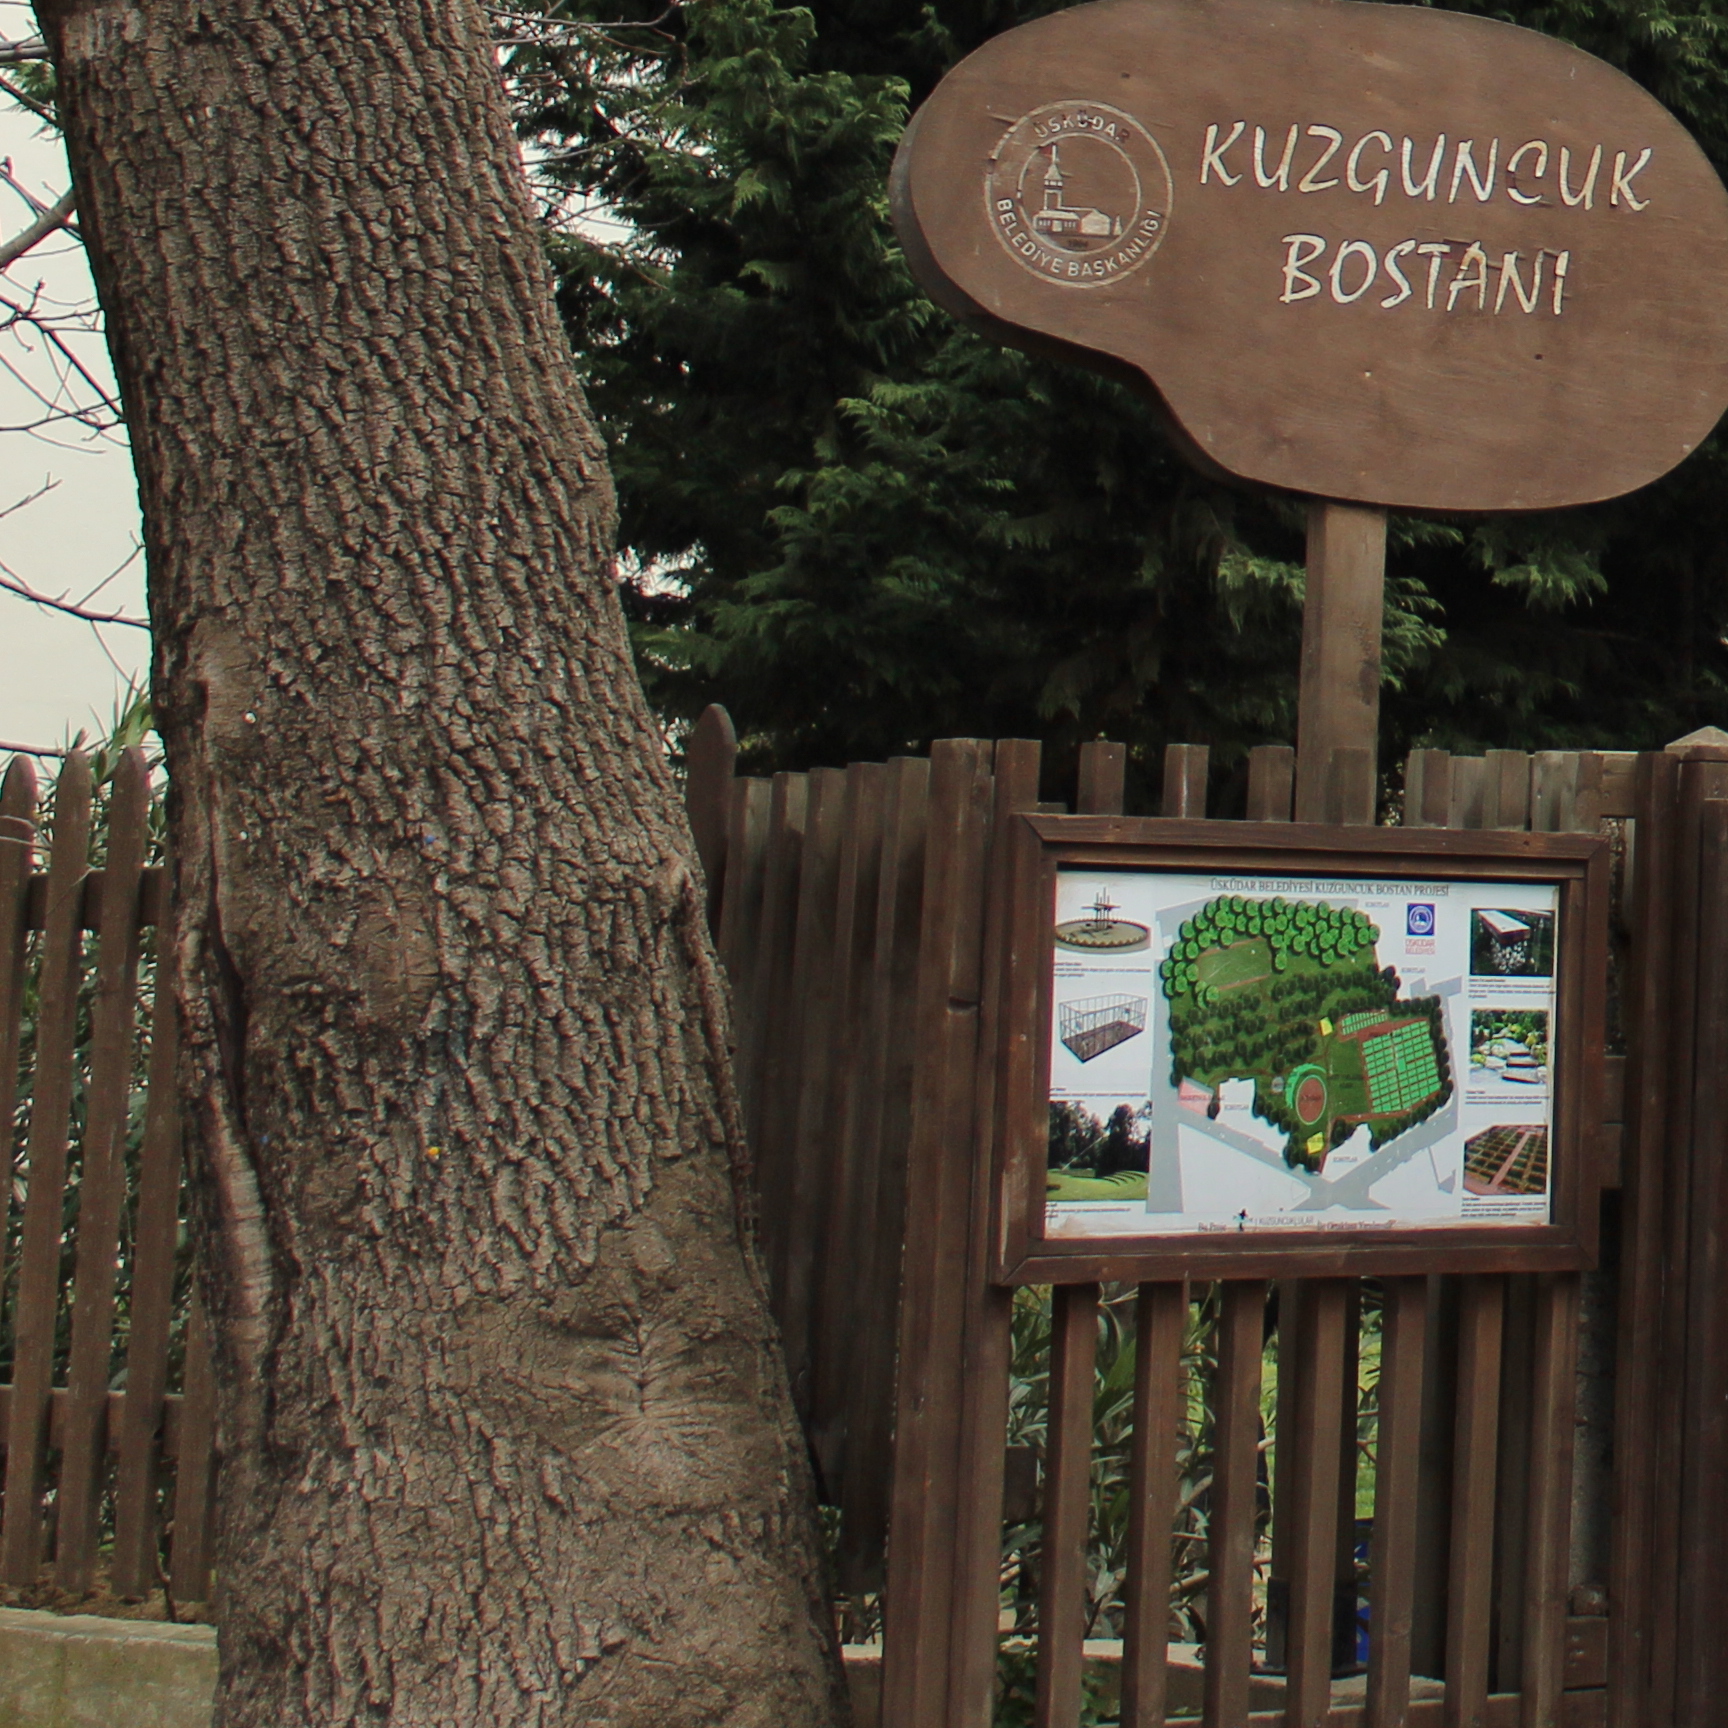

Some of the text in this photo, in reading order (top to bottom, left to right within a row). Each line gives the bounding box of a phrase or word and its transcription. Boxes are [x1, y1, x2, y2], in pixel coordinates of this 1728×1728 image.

[1200, 120, 1652, 212] KUZGUNCUK
[996, 199, 1163, 277] BELEDİYE BAŞKANLIĞI
[1279, 233, 1570, 316] BOSTANI
[1211, 878, 1256, 891] ÜSKÜDAR
[1259, 880, 1313, 892] BELEDİYESİ
[1315, 881, 1374, 894] KUZGUNCUK
[1376, 883, 1412, 895] BOSTAN
